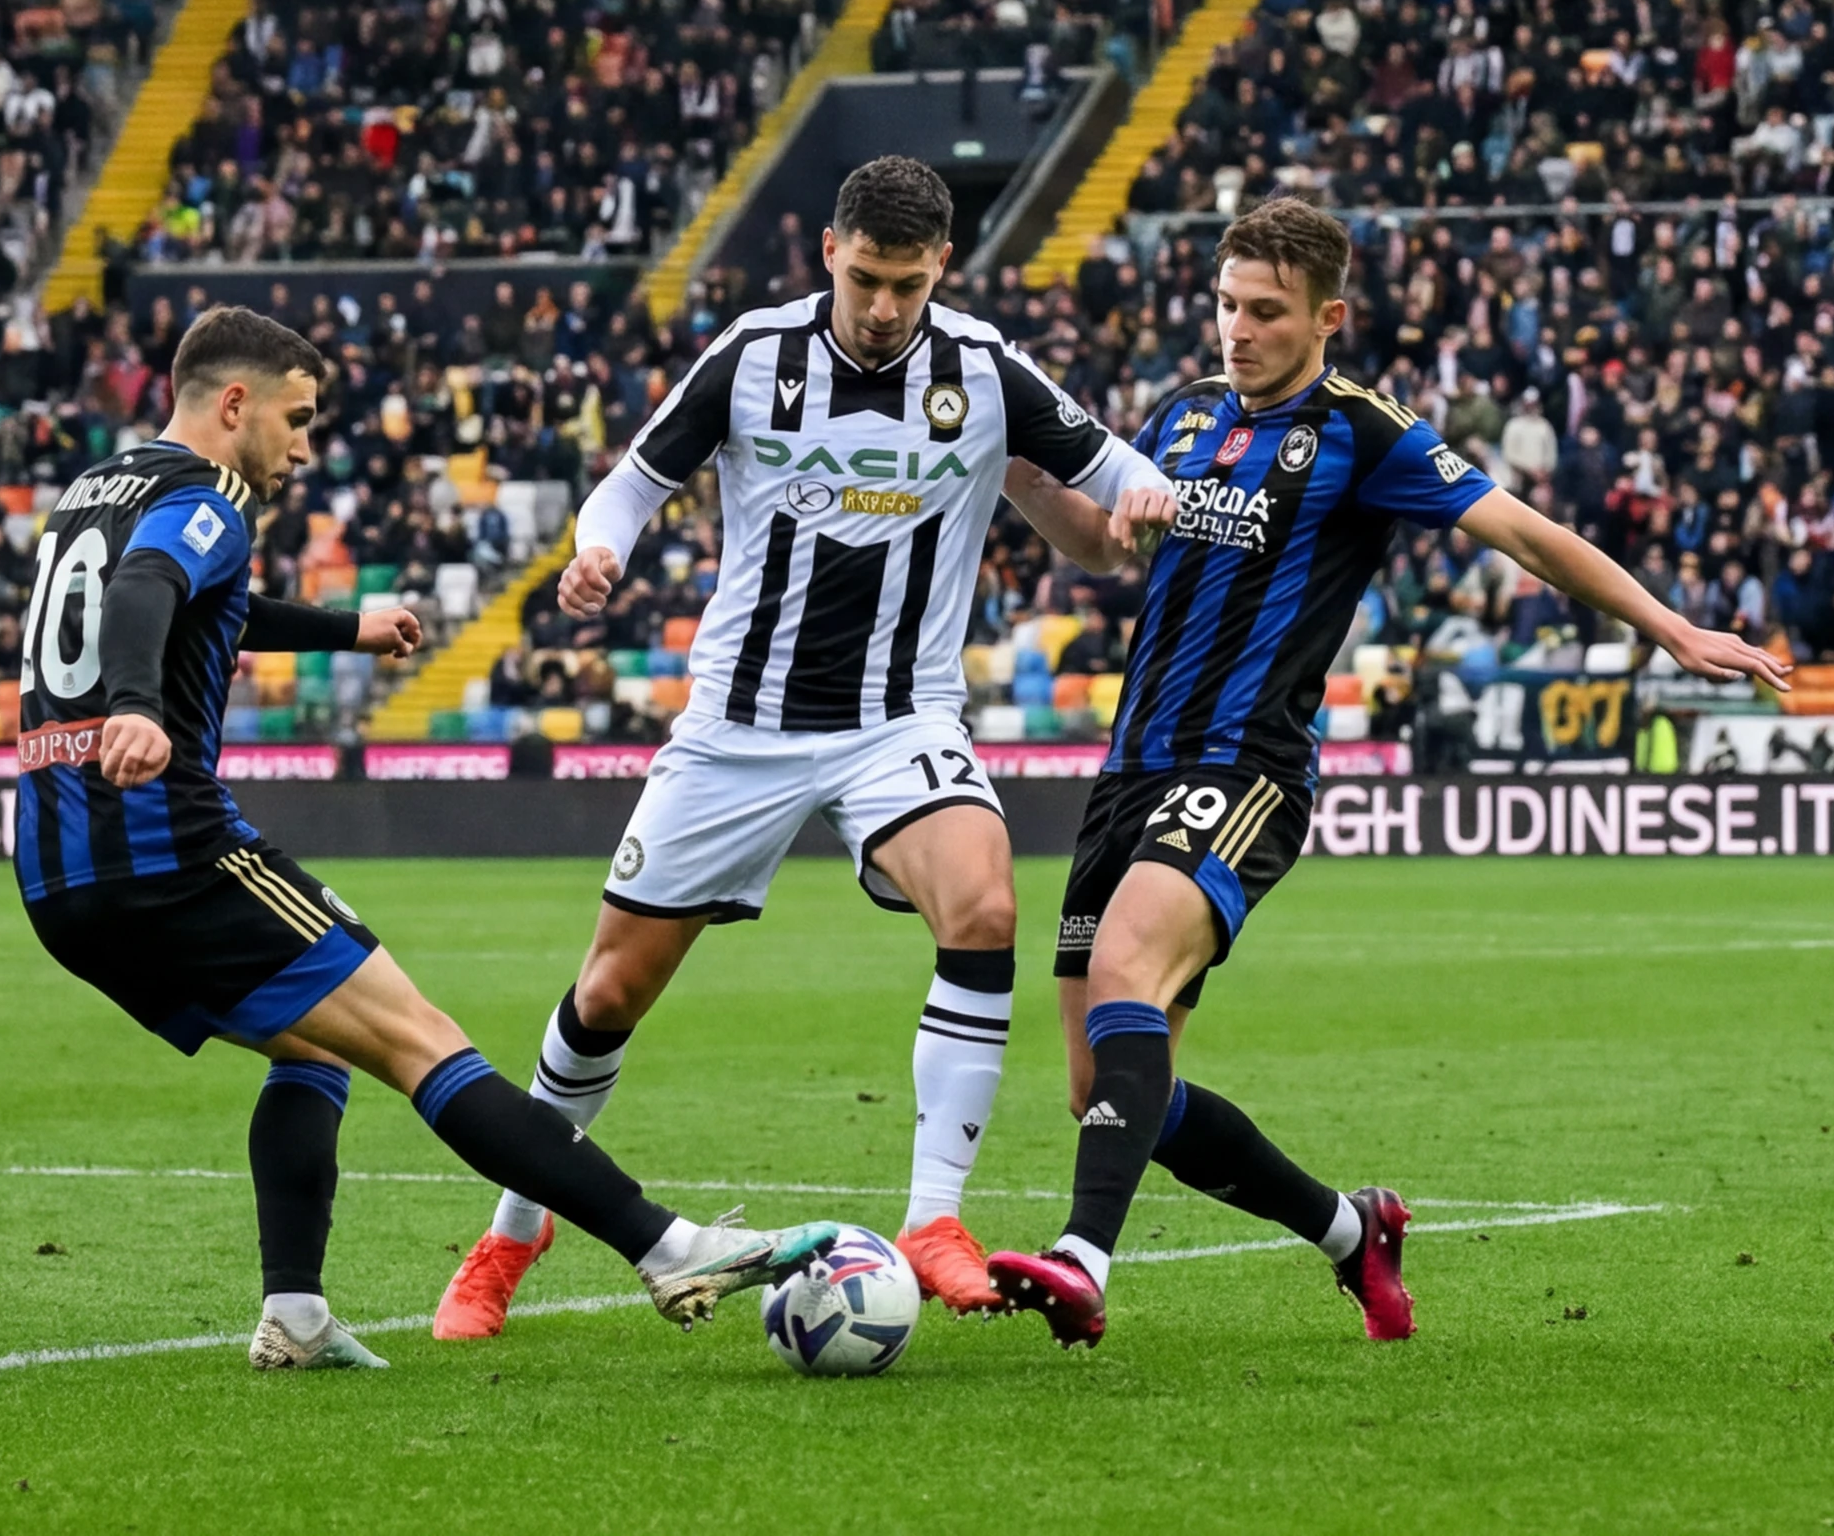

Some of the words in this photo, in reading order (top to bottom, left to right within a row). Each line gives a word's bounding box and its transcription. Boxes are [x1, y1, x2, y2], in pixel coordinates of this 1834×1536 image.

[753, 437, 969, 480] DACIA
[20, 527, 107, 698] 10
[910, 749, 985, 791] 12
[1146, 784, 1227, 830] 29
